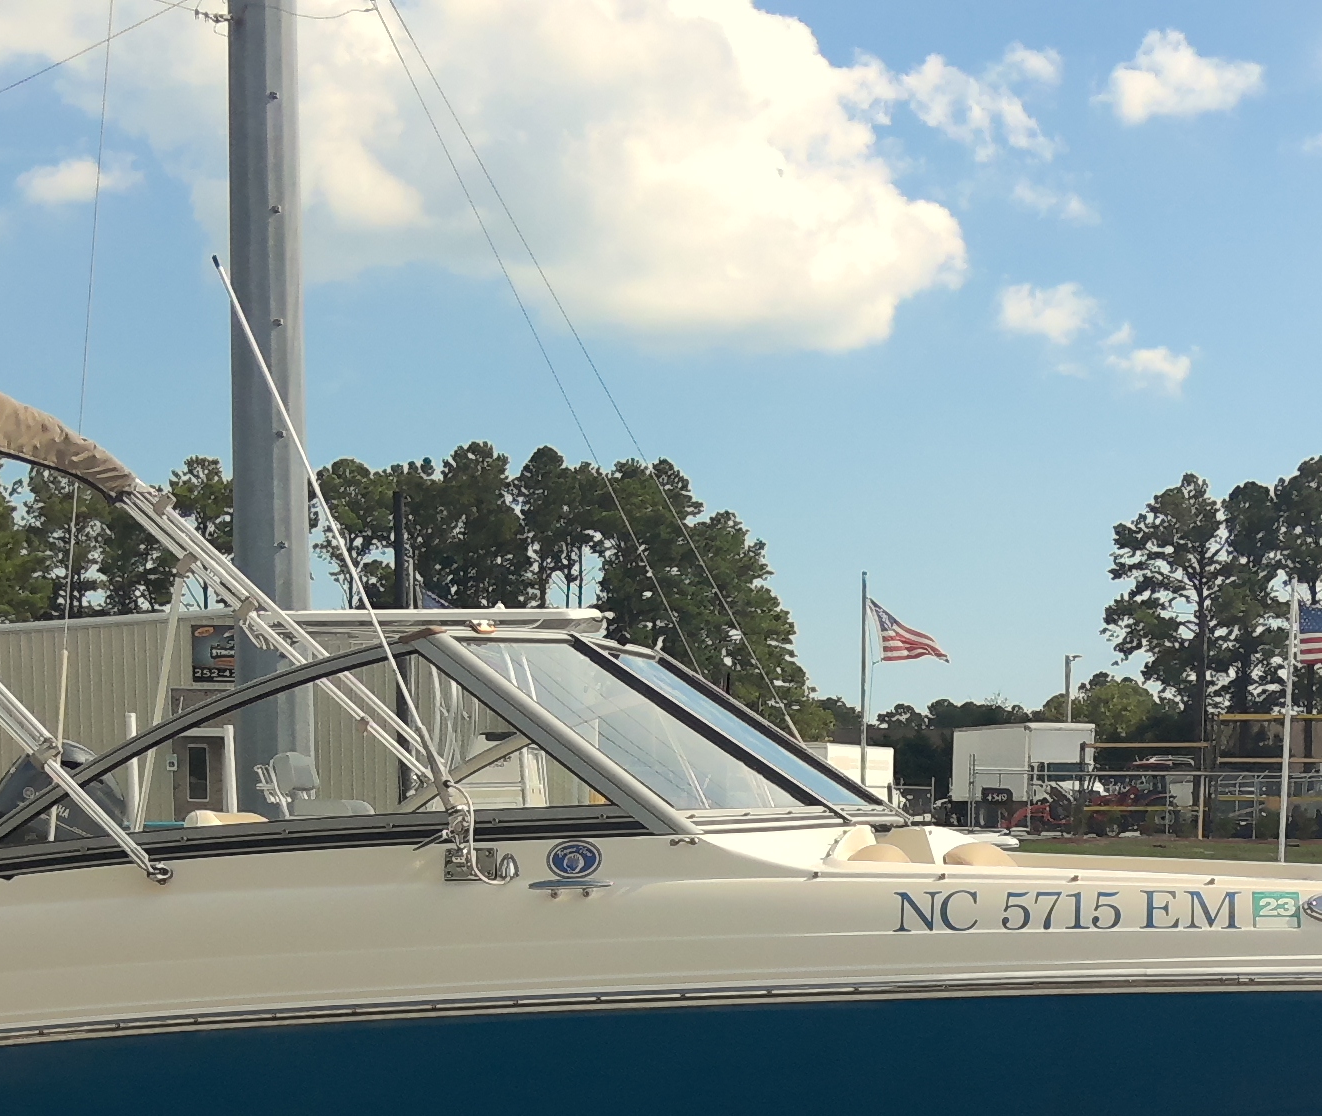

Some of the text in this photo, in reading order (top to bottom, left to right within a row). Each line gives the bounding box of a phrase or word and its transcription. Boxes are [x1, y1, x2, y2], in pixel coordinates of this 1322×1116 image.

[892, 889, 1243, 933] NC 5715 EM
[1259, 897, 1296, 916] 23
